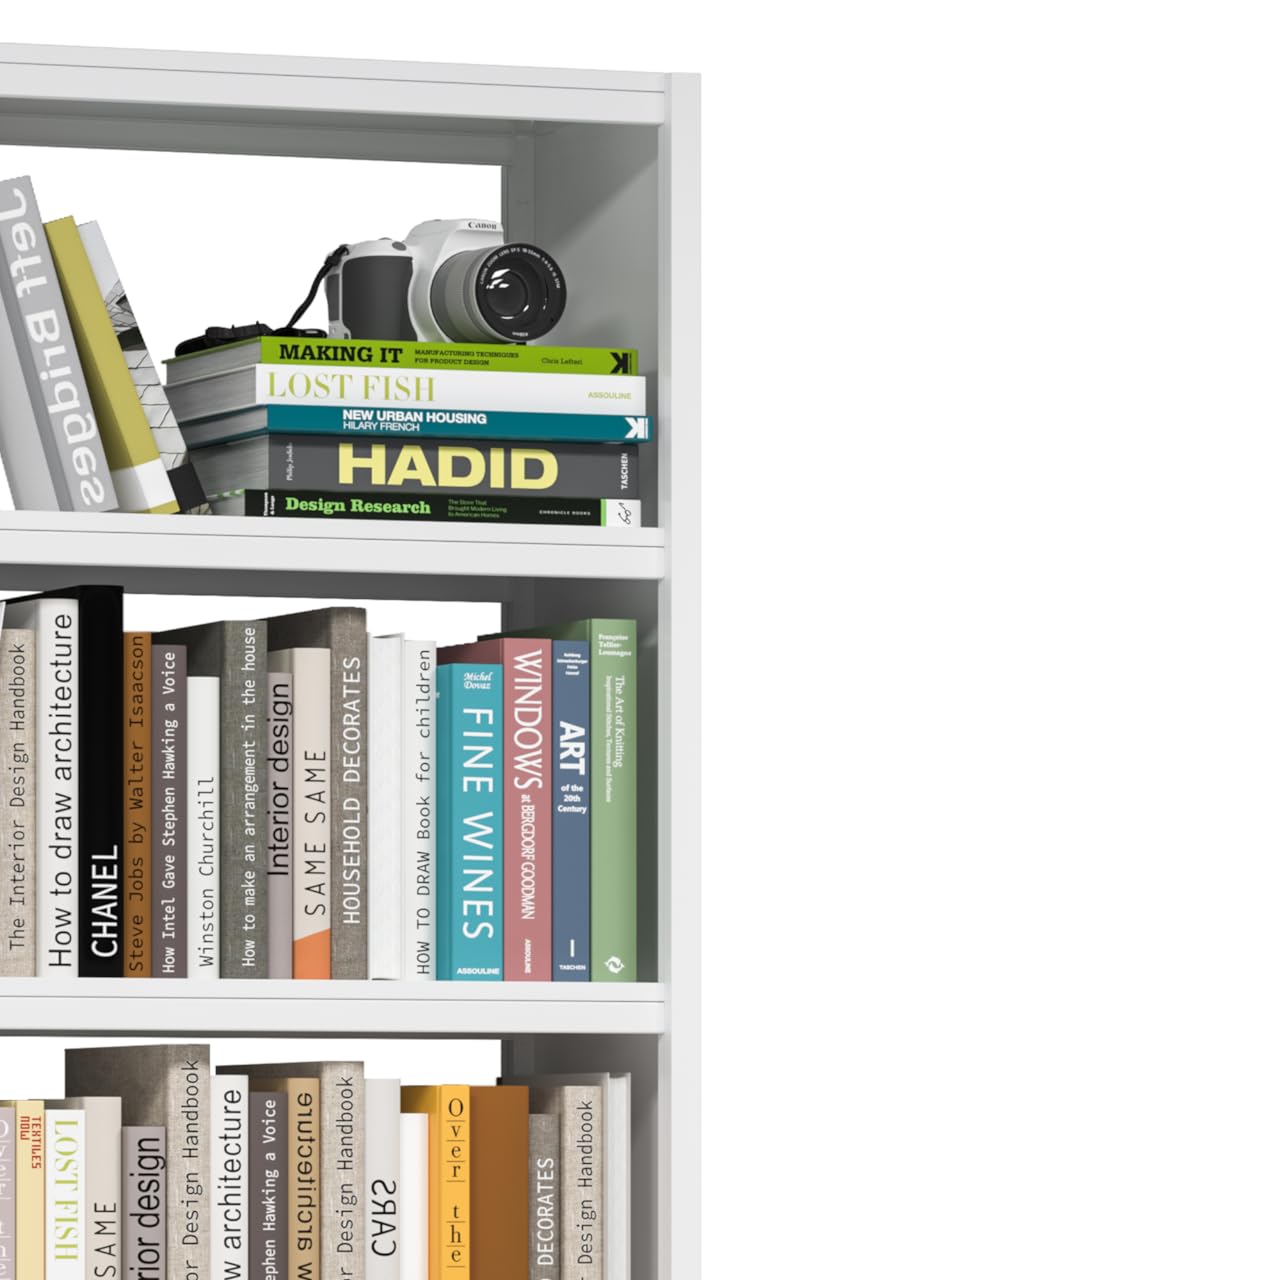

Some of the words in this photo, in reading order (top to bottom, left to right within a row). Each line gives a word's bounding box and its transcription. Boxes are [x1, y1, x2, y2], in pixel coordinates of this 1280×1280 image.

[280, 344, 373, 362] MAKING
[380, 348, 402, 363] IT
[415, 349, 475, 358] MANUFACTURING
[268, 371, 353, 399] LOST
[363, 374, 436, 401] FISH
[343, 409, 373, 420] NEW
[376, 410, 423, 422] URBAN
[427, 412, 486, 424] HOUSING
[343, 421, 378, 430] HILARY
[380, 422, 419, 431] FRENCH
[338, 443, 559, 490] HADID
[286, 497, 345, 514] Design
[351, 499, 431, 514] Research
[8, 644, 25, 730] Handbook
[48, 615, 72, 780] architecture
[128, 636, 143, 727] Isaacson
[161, 653, 175, 694] Voice
[464, 672, 492, 681] Michel
[464, 681, 490, 689] Dovaz
[267, 683, 293, 773] design
[343, 657, 360, 782] DECORATES
[514, 649, 542, 789] WINDOWS
[560, 721, 585, 775] ART
[8, 743, 29, 807] Design
[128, 741, 143, 810] Walter
[162, 720, 178, 779] Hawking
[463, 709, 493, 792] FINE
[304, 751, 326, 823] SAME
[522, 795, 531, 803] at
[558, 805, 587, 814] Century
[49, 793, 71, 859] draw
[129, 822, 146, 843] by
[162, 788, 178, 846] Stephen
[198, 777, 214, 876] Churchill
[267, 780, 289, 875] Interior
[521, 805, 535, 861] BERGDORF
[8, 820, 24, 905] Interior
[50, 872, 71, 896] to
[129, 857, 143, 901] Jobs
[162, 855, 175, 888] Gave
[304, 843, 326, 915] SAME
[343, 798, 360, 923] HOUSEHOLD
[463, 812, 493, 938] WINES
[91, 845, 117, 957] CHANEL
[161, 898, 175, 938] Intel
[521, 862, 535, 920] GOODMAN
[8, 919, 25, 950] The
[49, 908, 71, 966] How
[129, 915, 143, 971] Steve
[198, 889, 214, 966] Winston
[163, 947, 175, 972] How
[31, 1117, 41, 1168] TEXTILES
[55, 1121, 78, 1191] LOST
[129, 1137, 166, 1228] design
[55, 1201, 78, 1259] FISH
